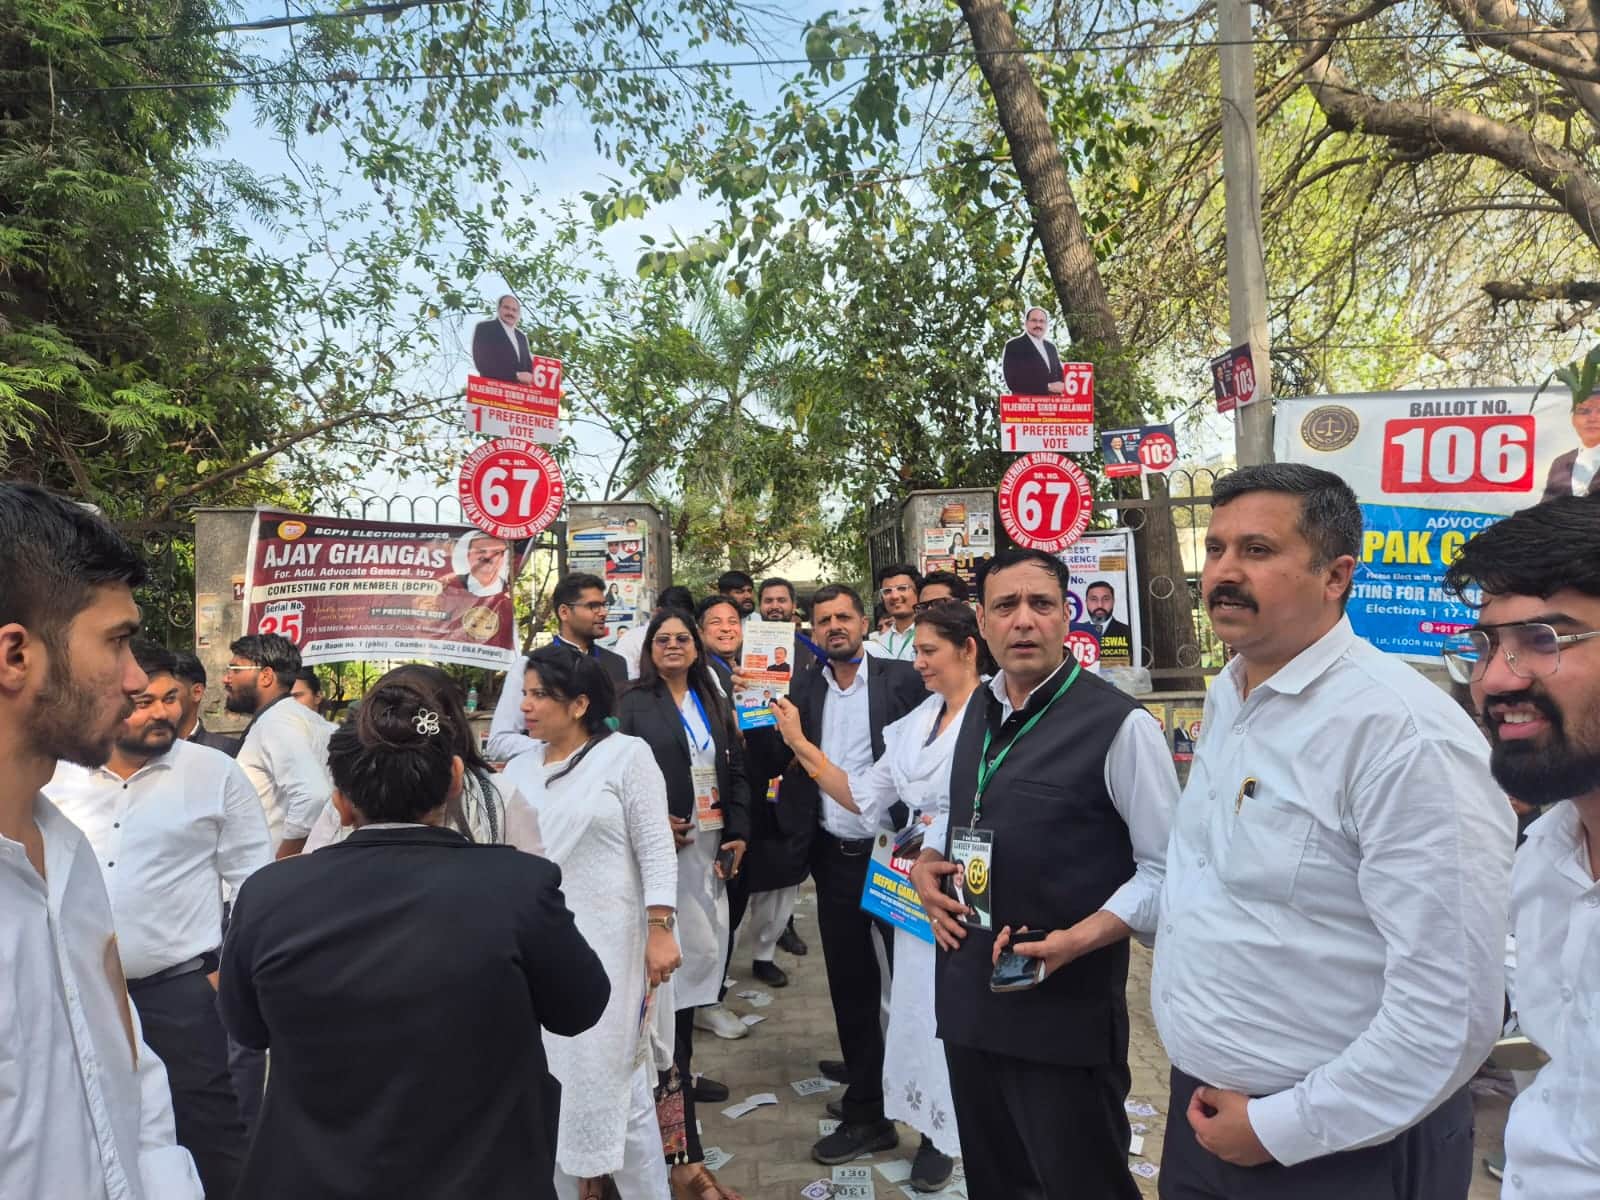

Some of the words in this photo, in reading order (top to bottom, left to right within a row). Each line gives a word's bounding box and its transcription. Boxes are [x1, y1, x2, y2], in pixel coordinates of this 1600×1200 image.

[533, 365, 560, 390] 67
[1065, 371, 1092, 396] 67
[1234, 367, 1254, 396] 103
[472, 405, 484, 432] 1
[489, 410, 555, 430] PREFERENCE
[1409, 400, 1478, 418] BALLOT
[1482, 399, 1512, 415] NO.
[508, 425, 535, 439] VOTE
[1006, 425, 1017, 450] 1
[1023, 425, 1089, 436] PREFERENCE
[1042, 438, 1068, 449] VOTE
[1141, 443, 1173, 465] 103
[1391, 424, 1528, 484] 106
[461, 442, 495, 480] VIJENDER
[495, 439, 527, 451] SINGH
[526, 443, 561, 480] AHLAWAT
[1001, 454, 1033, 496] VIJENDER
[1031, 452, 1059, 465] SINGH
[1060, 454, 1091, 498] AHLAWAT
[480, 465, 540, 517] 67
[1017, 480, 1072, 532] 67
[314, 526, 350, 539] BCPH
[351, 530, 416, 539] ELECTIONS
[497, 527, 527, 539] SINGH
[263, 544, 323, 568] AJAY
[328, 543, 449, 568] GHANGAS
[1031, 540, 1059, 552] SINGH
[1358, 530, 1432, 565] PAK
[1440, 531, 1481, 567] G
[294, 568, 317, 579] Add.
[319, 567, 368, 578] Advocate
[1070, 576, 1087, 585] No.
[266, 582, 326, 597] CONTESTING
[328, 581, 350, 594] FOR
[352, 581, 399, 592] MEMBER
[401, 581, 439, 593] (BCPH)
[1396, 585, 1425, 602] FOR
[265, 602, 288, 613] Serial
[289, 601, 305, 612] No.
[1366, 603, 1427, 616] Elections
[1444, 607, 1481, 619] 17-18
[1392, 638, 1421, 647] FLOOR
[969, 860, 985, 885] 69
